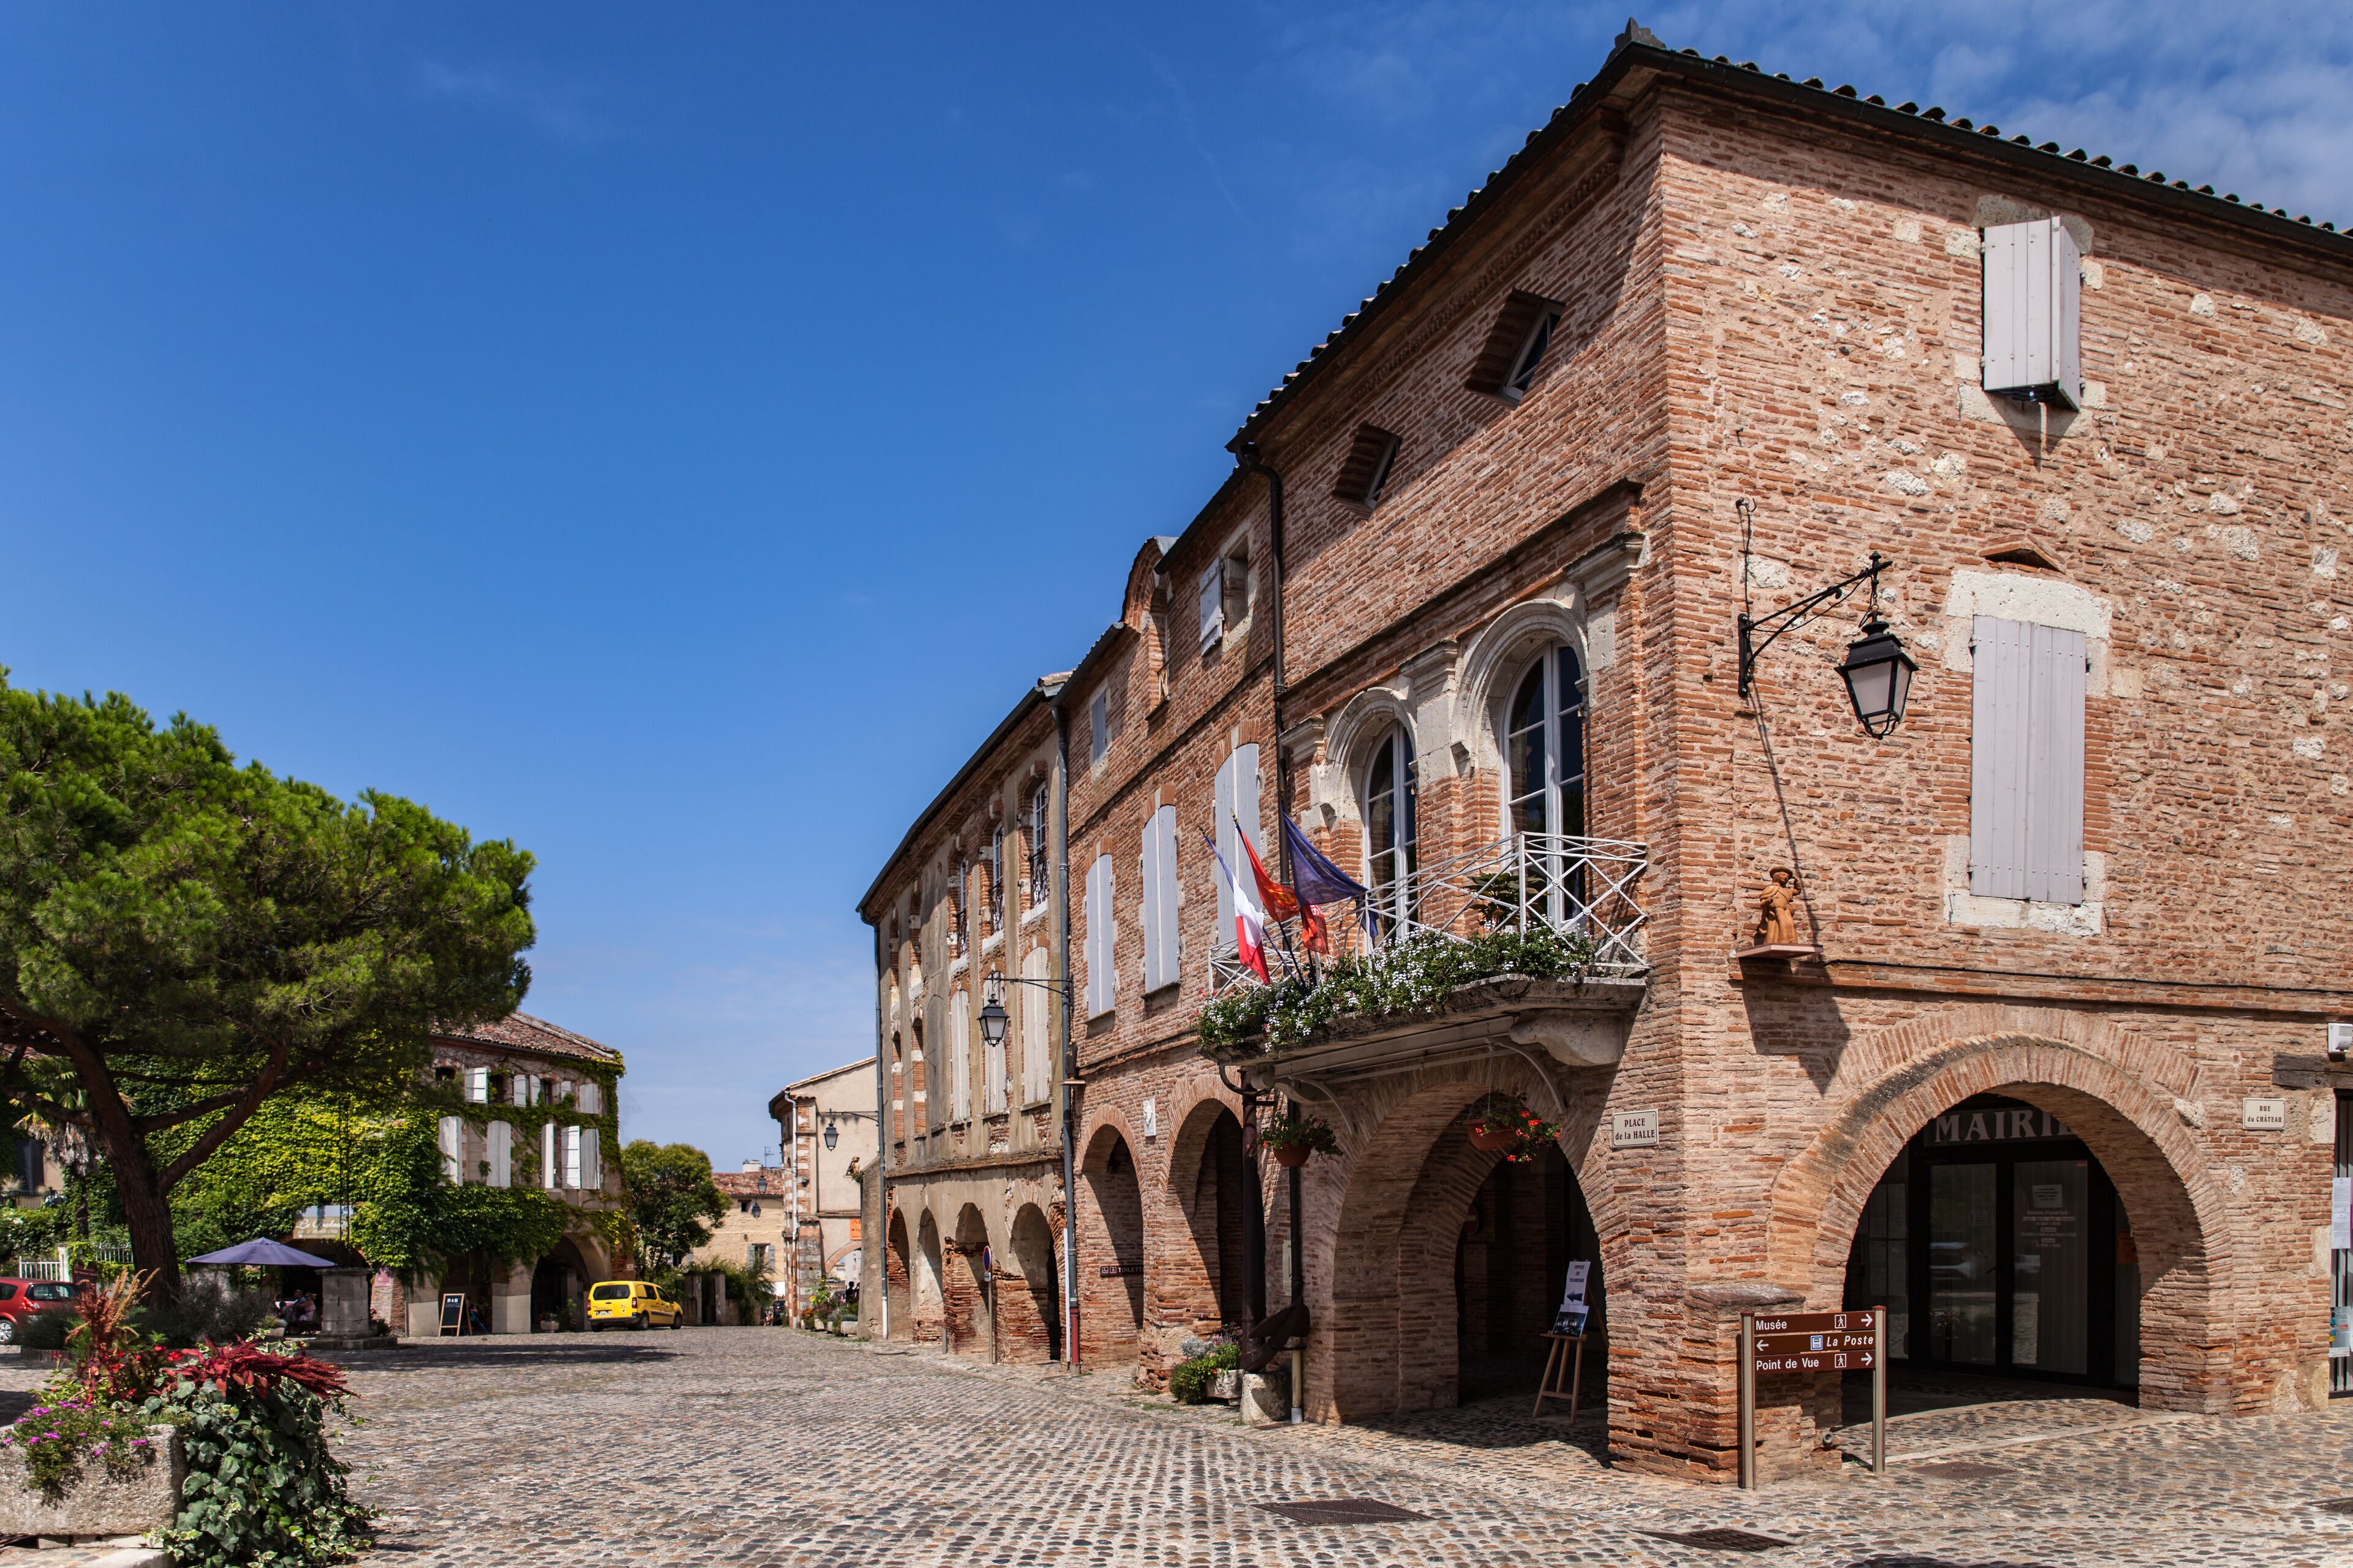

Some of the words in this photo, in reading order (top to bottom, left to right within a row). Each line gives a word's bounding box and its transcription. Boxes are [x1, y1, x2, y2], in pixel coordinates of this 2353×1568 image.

[1624, 1118, 1645, 1127] PLACE
[1633, 1130, 1655, 1138] HALLE
[1756, 1319, 1787, 1330] Musée
[1827, 1336, 1838, 1347] La
[1844, 1335, 1874, 1346] Poste
[1756, 1360, 1781, 1371] Point
[1785, 1358, 1797, 1369] de
[1802, 1357, 1819, 1368] Vue
